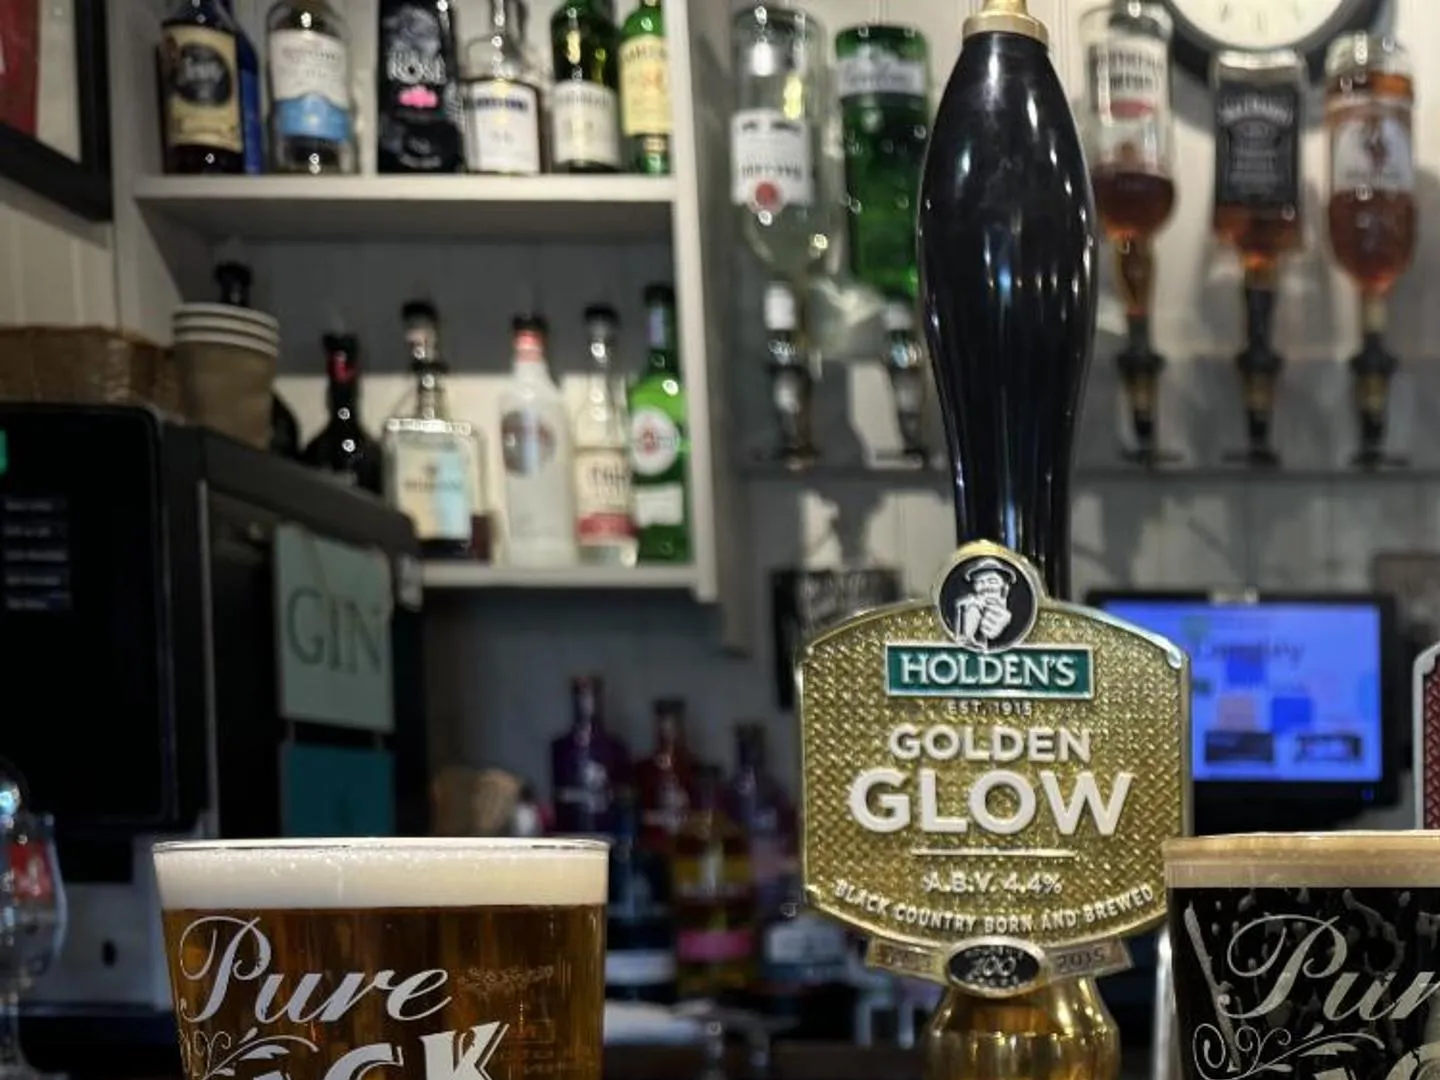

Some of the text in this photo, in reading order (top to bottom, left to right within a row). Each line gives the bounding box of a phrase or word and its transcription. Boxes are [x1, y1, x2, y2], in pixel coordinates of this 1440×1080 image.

[286, 586, 386, 674] GIN
[900, 653, 1076, 687] HOLDEN'S
[889, 723, 1092, 763] GOLDEN
[849, 768, 1133, 835] GLOW
[1003, 871, 1062, 894] 4.4%
[834, 879, 1154, 934] BLACK COUNTRY BORN AND BREWED
[179, 916, 453, 1024] Pure
[1058, 946, 1104, 972] 2015
